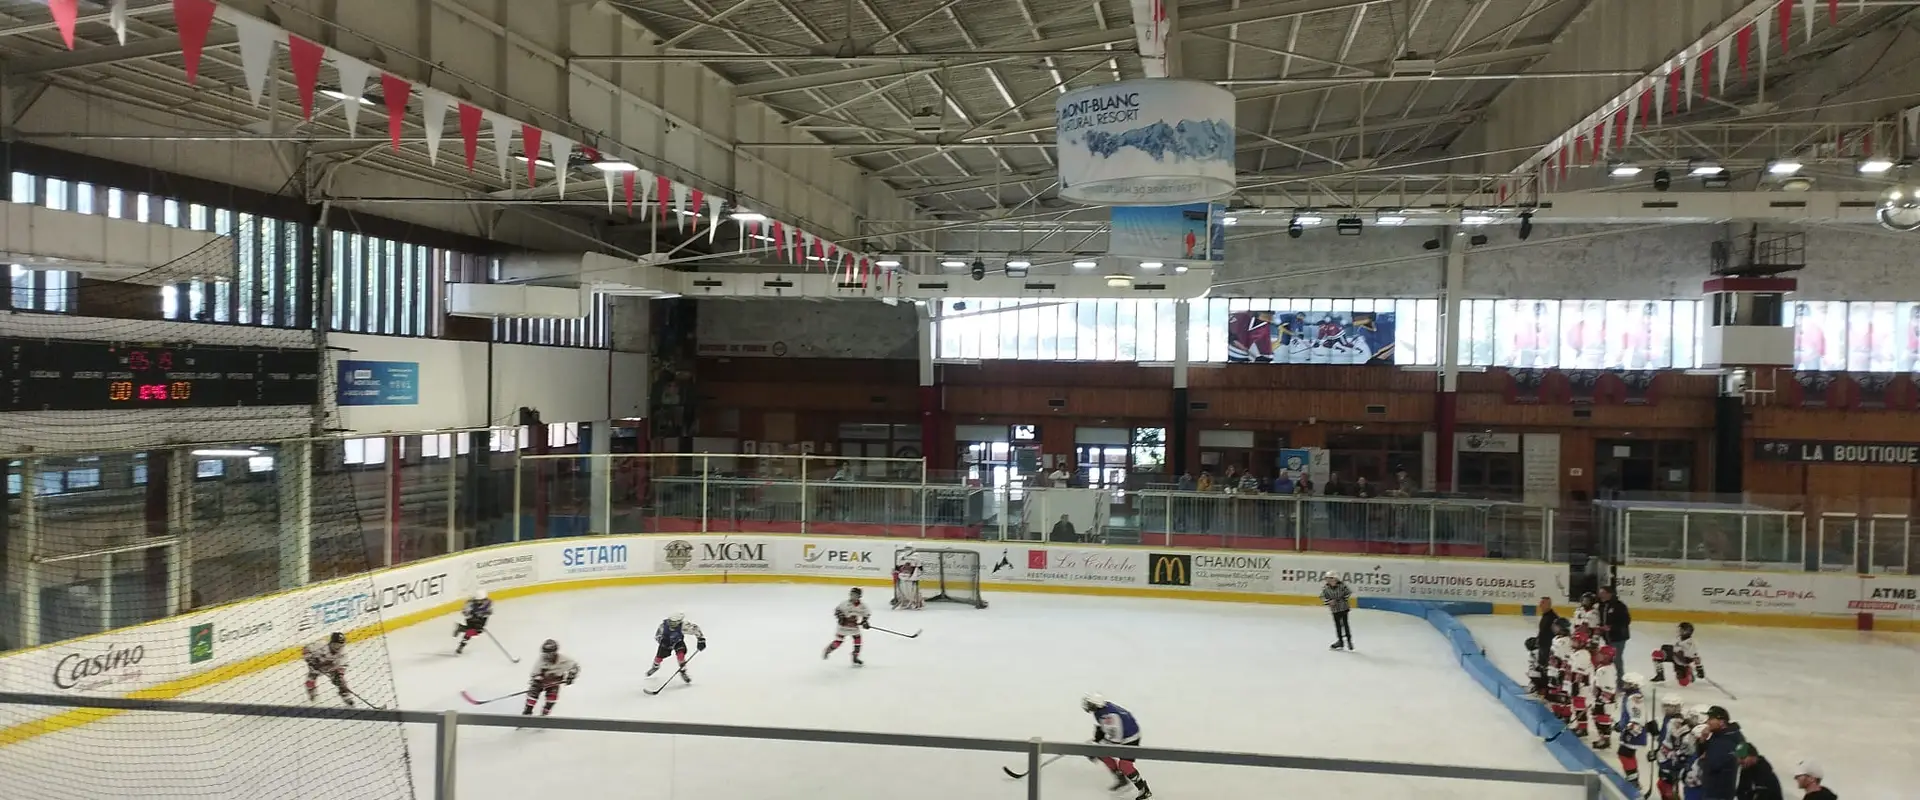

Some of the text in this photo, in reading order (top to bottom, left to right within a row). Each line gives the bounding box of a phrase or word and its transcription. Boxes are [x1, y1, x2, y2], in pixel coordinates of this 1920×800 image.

[1061, 92, 1140, 120] MONT-BLANC
[1096, 108, 1140, 125] RESORT
[1801, 444, 1919, 463] LA BOUTIQUE
[562, 544, 628, 567] SETAM
[699, 542, 769, 561] MGM
[828, 550, 873, 563] PEAK
[1194, 555, 1271, 570] CHAMONIX
[1409, 574, 1537, 589] SOLUTIONS GLOBALES
[1466, 589, 1478, 598] DE
[1701, 587, 1817, 599] SPARALPINA
[1870, 587, 1917, 600] ATMB
[53, 643, 144, 690] Casino
